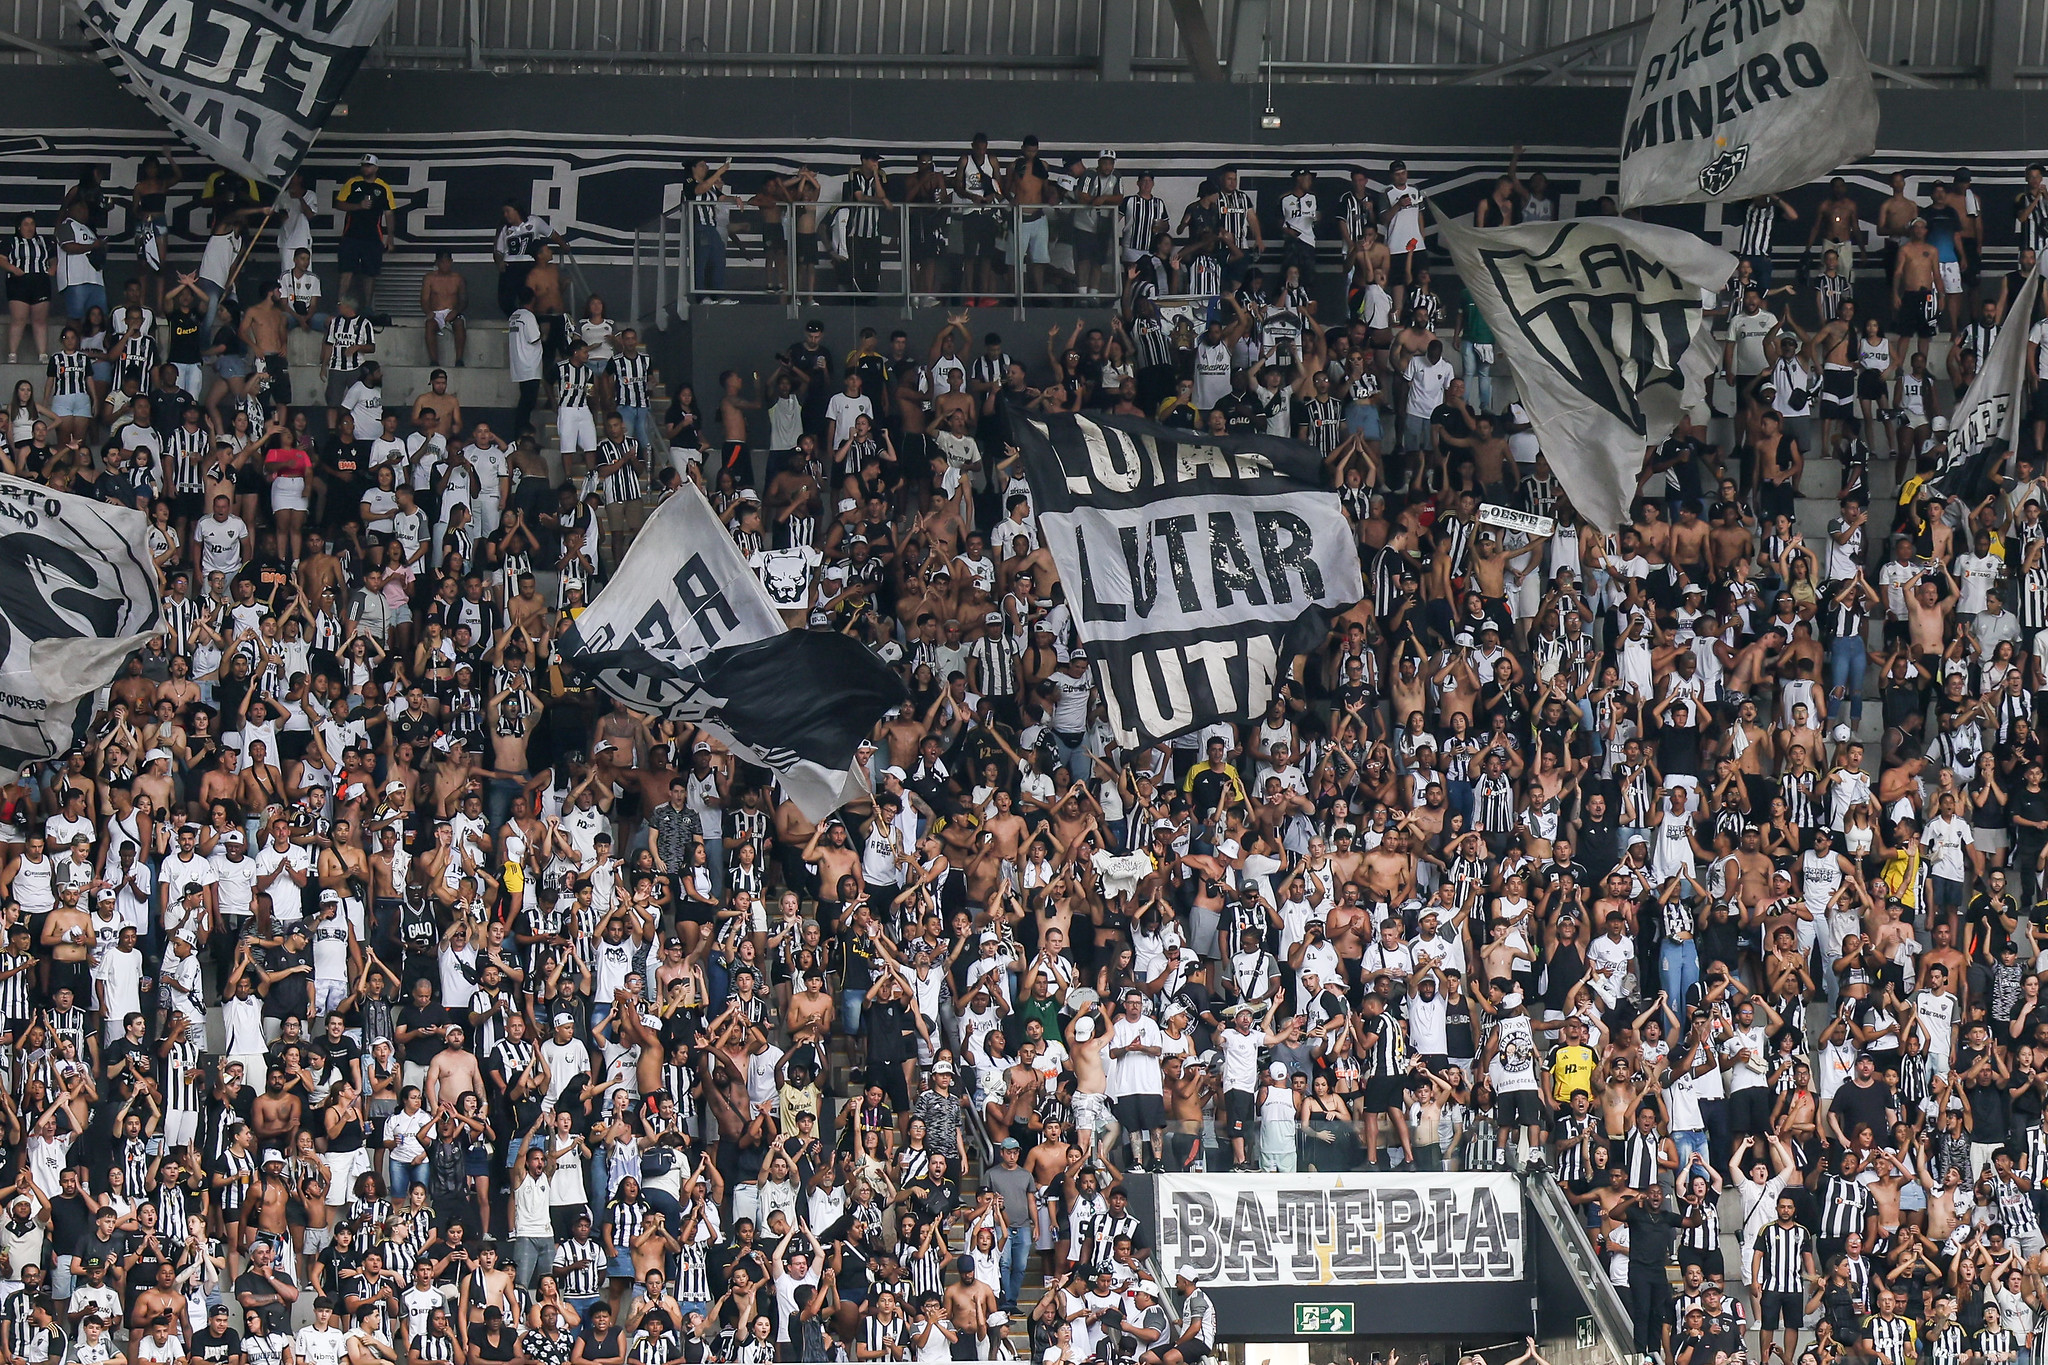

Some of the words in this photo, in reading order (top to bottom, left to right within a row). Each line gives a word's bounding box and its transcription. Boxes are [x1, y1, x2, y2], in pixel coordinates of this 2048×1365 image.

[1623, 42, 1828, 161] MINEIRO
[1524, 242, 1684, 293] CAM
[1230, 417, 1250, 426] GALO
[1491, 507, 1538, 525] OESTE
[156, 542, 168, 551] H2
[1076, 511, 1326, 622] LUTAR
[1970, 571, 1991, 579] BETANO
[408, 921, 432, 939] GALO
[1925, 1011, 1947, 1020] BETANO
[1172, 1186, 1515, 1282] BATERIA
[142, 1256, 157, 1264] BETA
[320, 1353, 335, 1362] bmg
